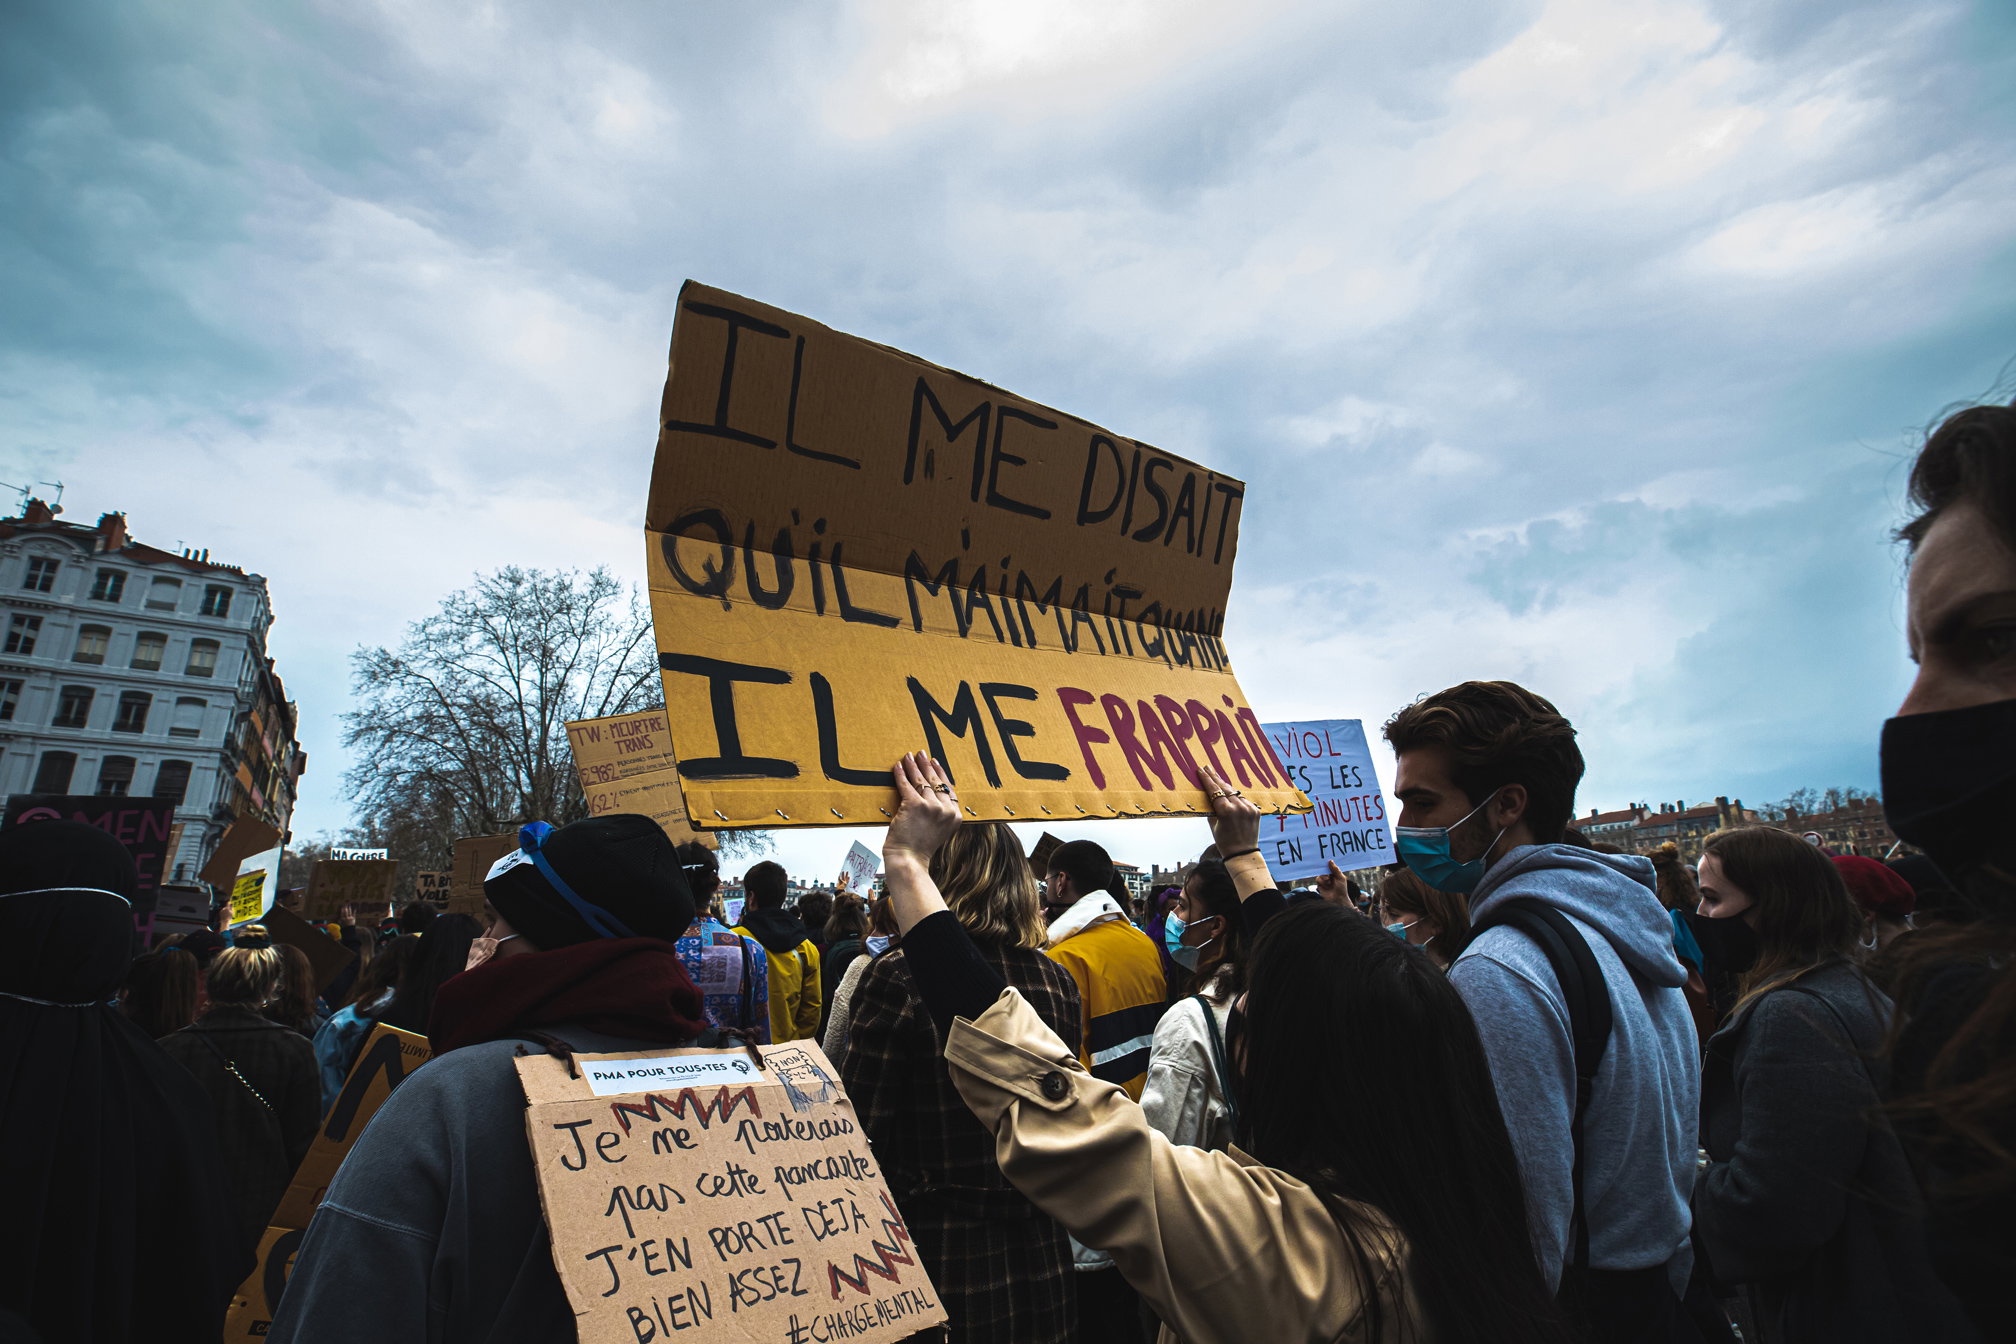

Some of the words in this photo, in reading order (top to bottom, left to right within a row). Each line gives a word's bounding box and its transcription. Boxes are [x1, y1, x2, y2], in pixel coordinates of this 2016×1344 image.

[664, 299, 862, 470] IL
[902, 375, 1059, 520] ME
[1076, 433, 1244, 565] DISAIT
[609, 716, 666, 739] MEURTRE
[659, 651, 898, 788] IL
[905, 674, 1072, 789] ME
[614, 734, 654, 754] TRANS
[1273, 726, 1342, 759] VIOL
[581, 763, 620, 787] 2982
[1329, 764, 1363, 790] LES
[1303, 794, 1385, 830] MINUTES
[331, 849, 348, 861] MA
[1276, 836, 1303, 866] EN
[1317, 828, 1387, 860] FRANCE
[419, 874, 436, 889] TA
[592, 1069, 626, 1082] PMA
[628, 1067, 665, 1079] POUR
[779, 1055, 801, 1067] NON
[553, 1118, 628, 1172] Je
[604, 1182, 686, 1239] pas
[695, 1160, 767, 1199] cette
[774, 1149, 876, 1202] pancarte
[584, 1236, 694, 1298] J'EN
[708, 1210, 795, 1262] PORTE
[801, 1187, 871, 1243] DÉJÀ
[625, 1280, 714, 1344] BIEN
[728, 1257, 809, 1313] ASSEZ
